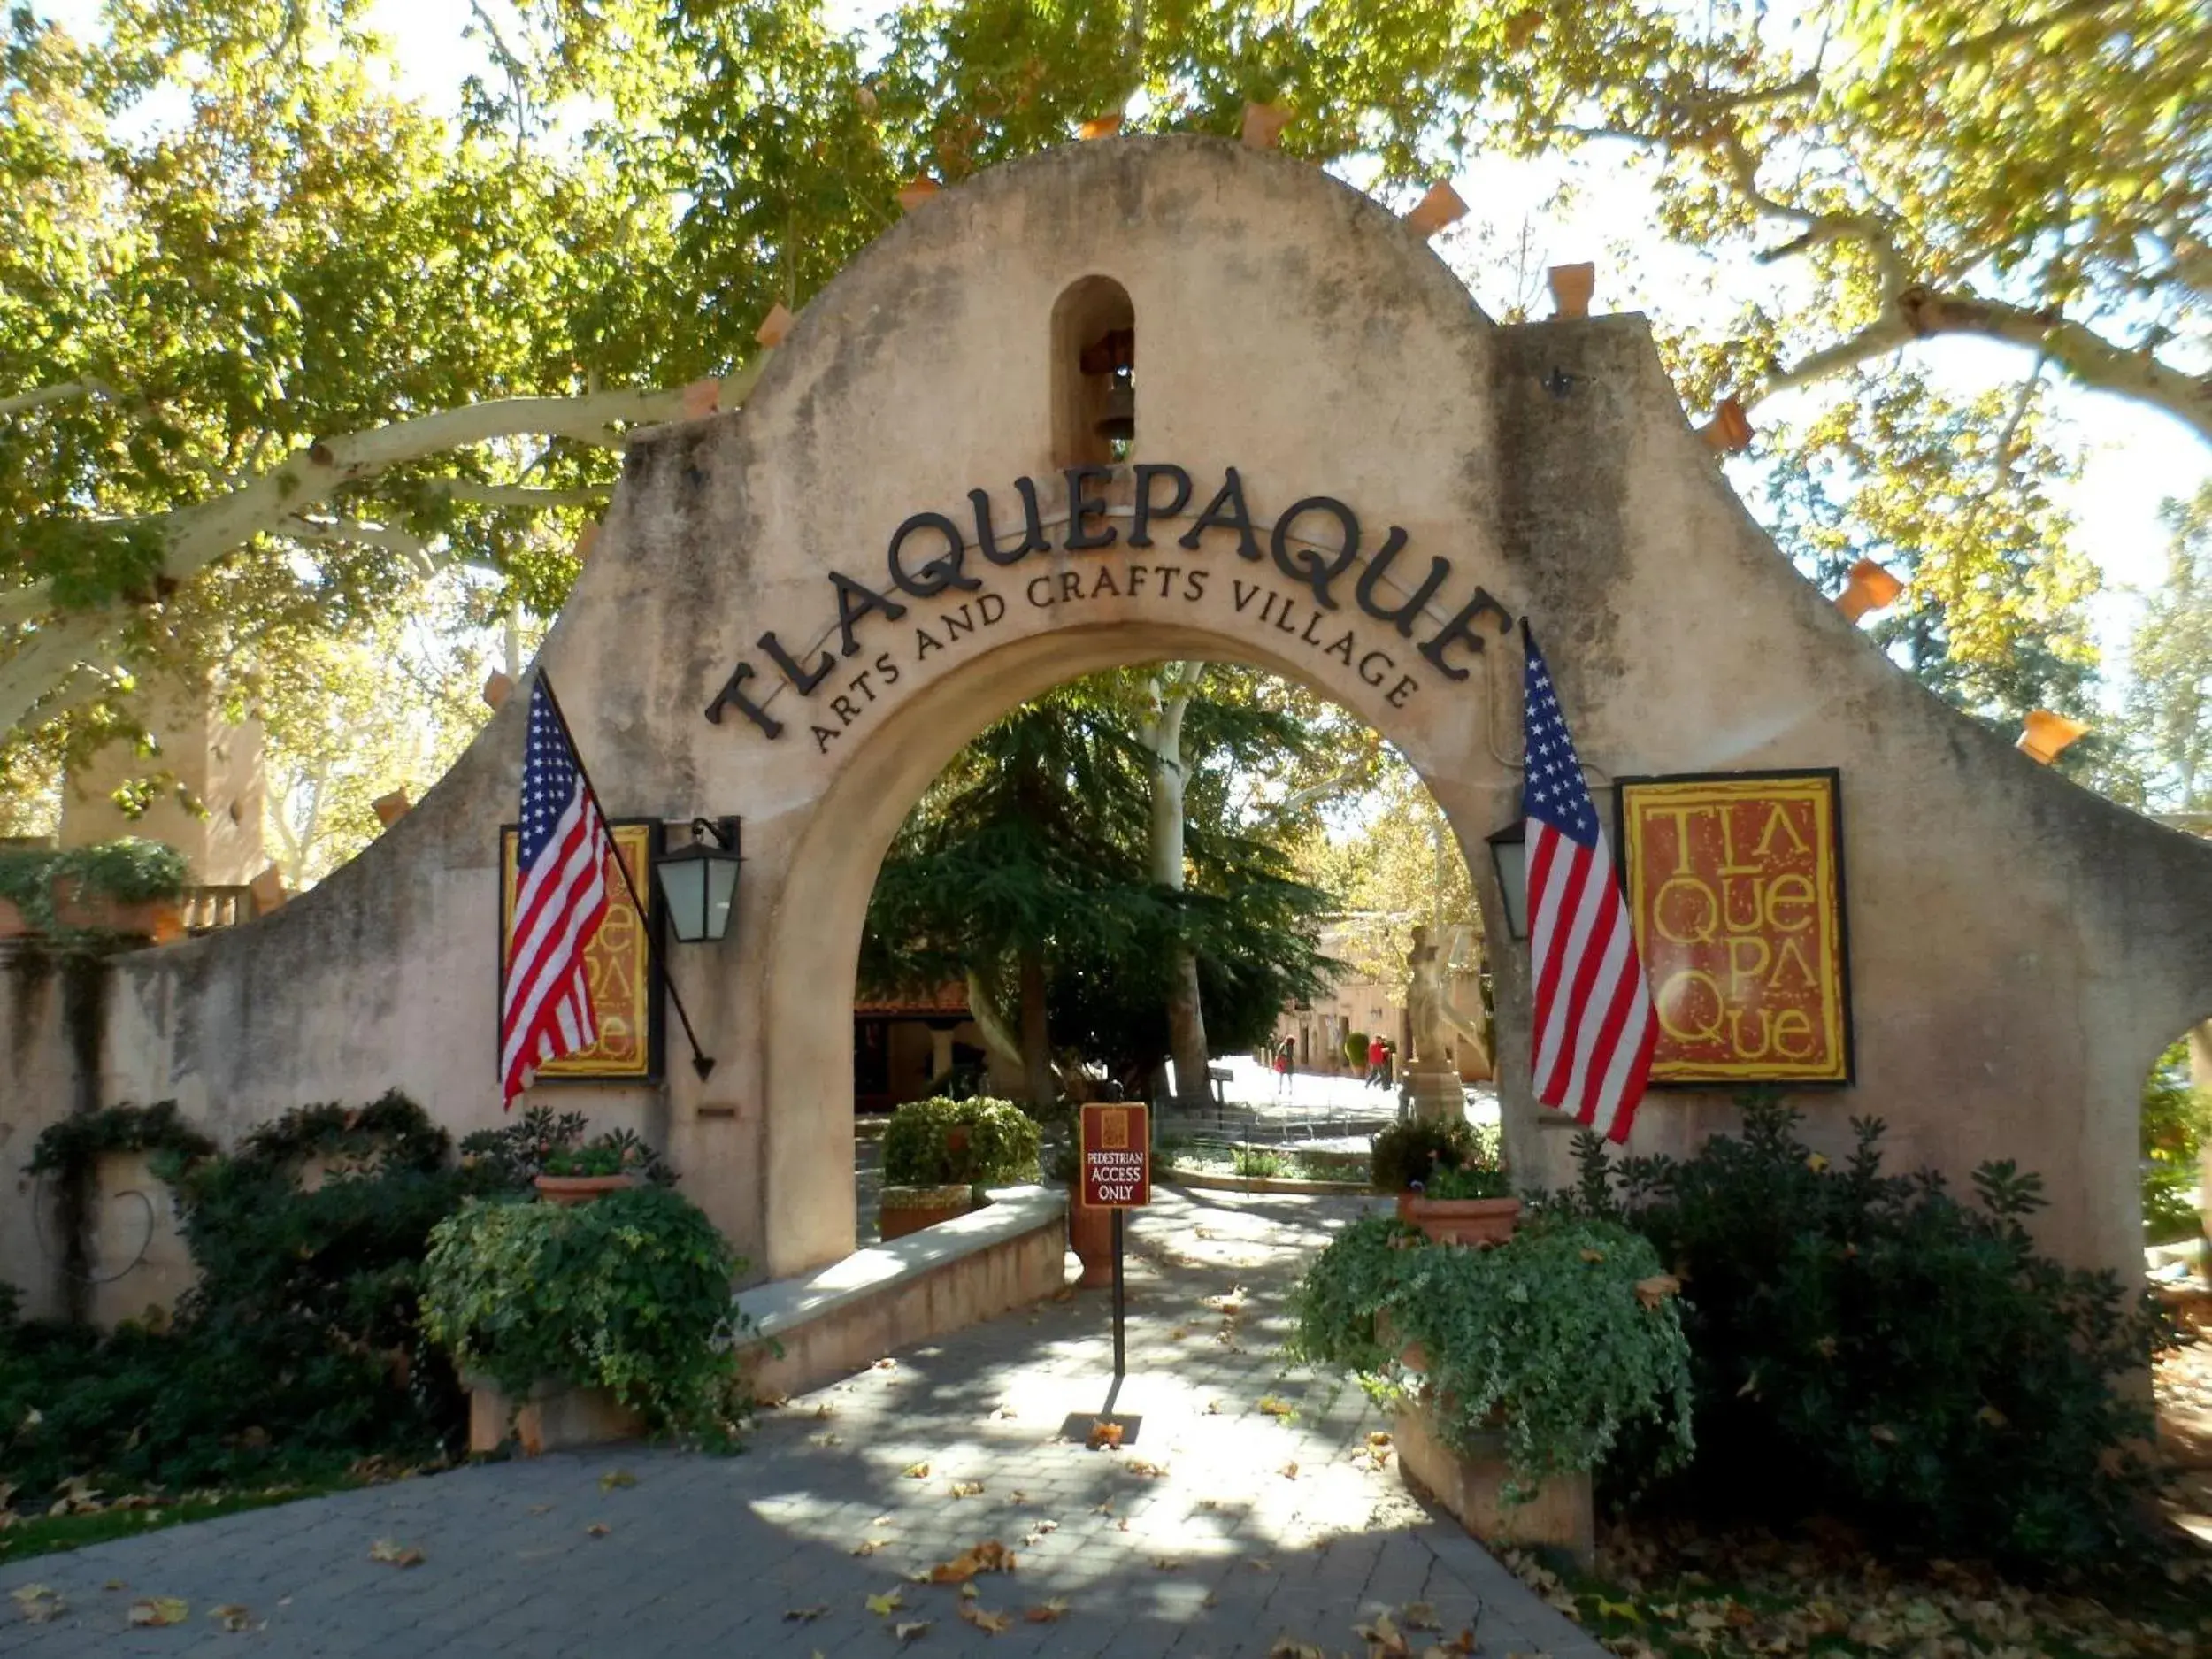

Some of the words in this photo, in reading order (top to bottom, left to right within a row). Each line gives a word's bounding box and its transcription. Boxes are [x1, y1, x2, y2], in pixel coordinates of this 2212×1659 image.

[705, 463, 1513, 741] TLAQUEPAQUE
[810, 652, 901, 754] ARTS
[914, 593, 1006, 661] AND
[1026, 565, 1210, 609] CRAFTS
[1232, 580, 1421, 710] VILLAGE
[1645, 801, 1811, 876] TLA
[1724, 936, 1819, 1002] PA
[1087, 1152, 1144, 1165] PEDESTRIAN
[1091, 1166, 1141, 1183] ACCESS
[1098, 1184, 1133, 1201] ONLY
